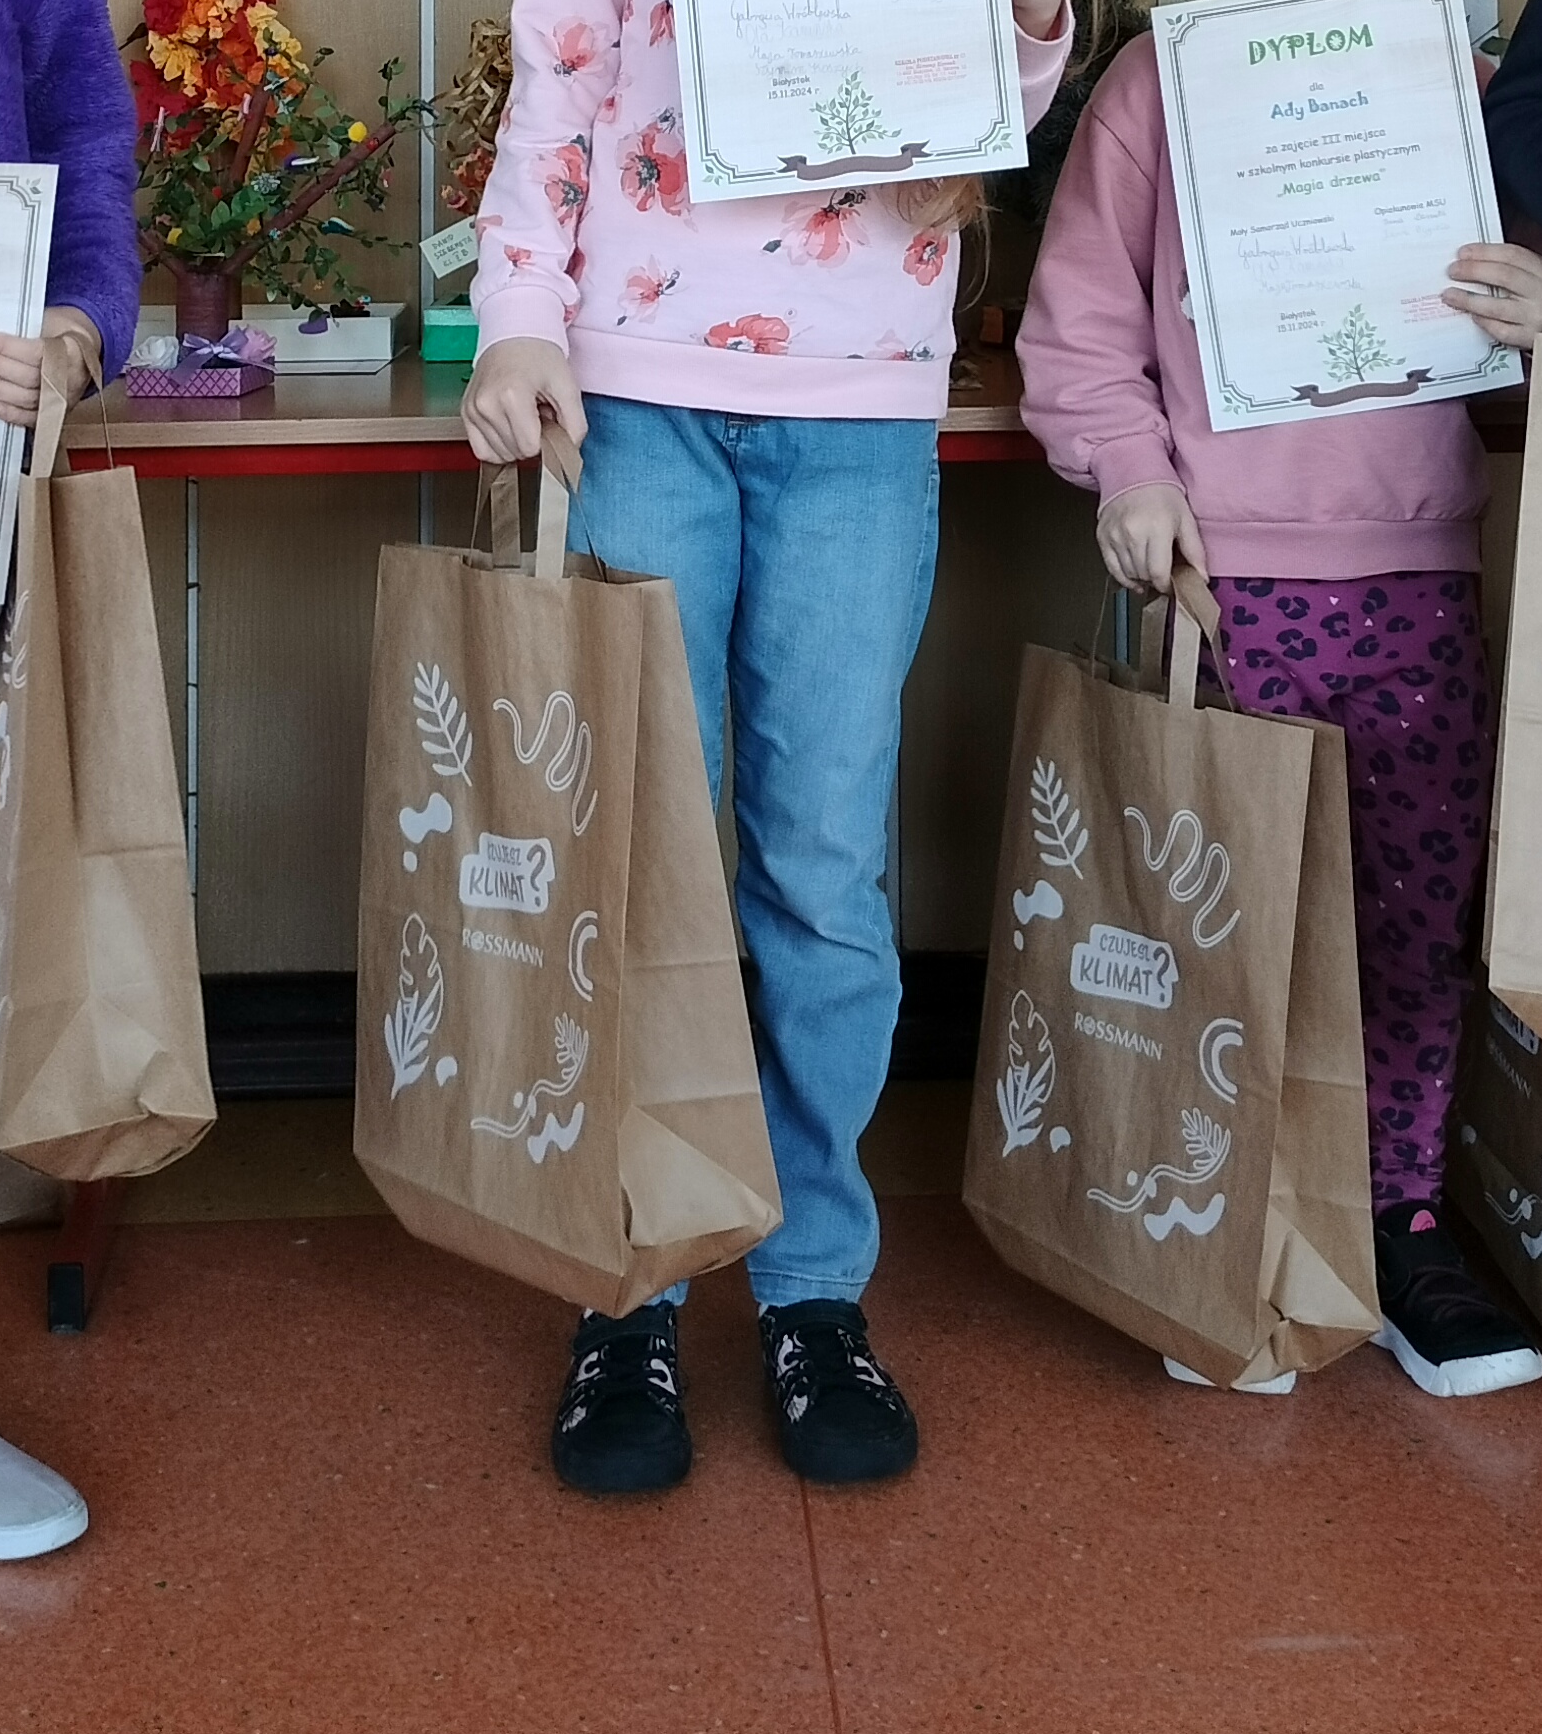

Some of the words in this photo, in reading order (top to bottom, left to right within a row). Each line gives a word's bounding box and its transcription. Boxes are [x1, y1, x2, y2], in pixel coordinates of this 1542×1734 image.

[1249, 24, 1374, 65] DYPLOM
[768, 87, 812, 100] 15.11.2024
[1309, 82, 1324, 92] dla
[1271, 102, 1304, 120] Ady
[1308, 91, 1369, 114] Banach
[1265, 145, 1278, 154] za
[1281, 138, 1319, 153] zajęcie
[1321, 134, 1341, 145] III
[1345, 128, 1386, 142] miejsca
[1237, 170, 1245, 178] w
[1249, 162, 1296, 177] szkolnym
[1300, 154, 1351, 169] konkursie
[1354, 144, 1420, 163] plastycznym
[463, 928, 544, 968] ROSSMANN
[1100, 933, 1150, 962] CZUJESZ
[1075, 1012, 1162, 1060] ROSSMANN
